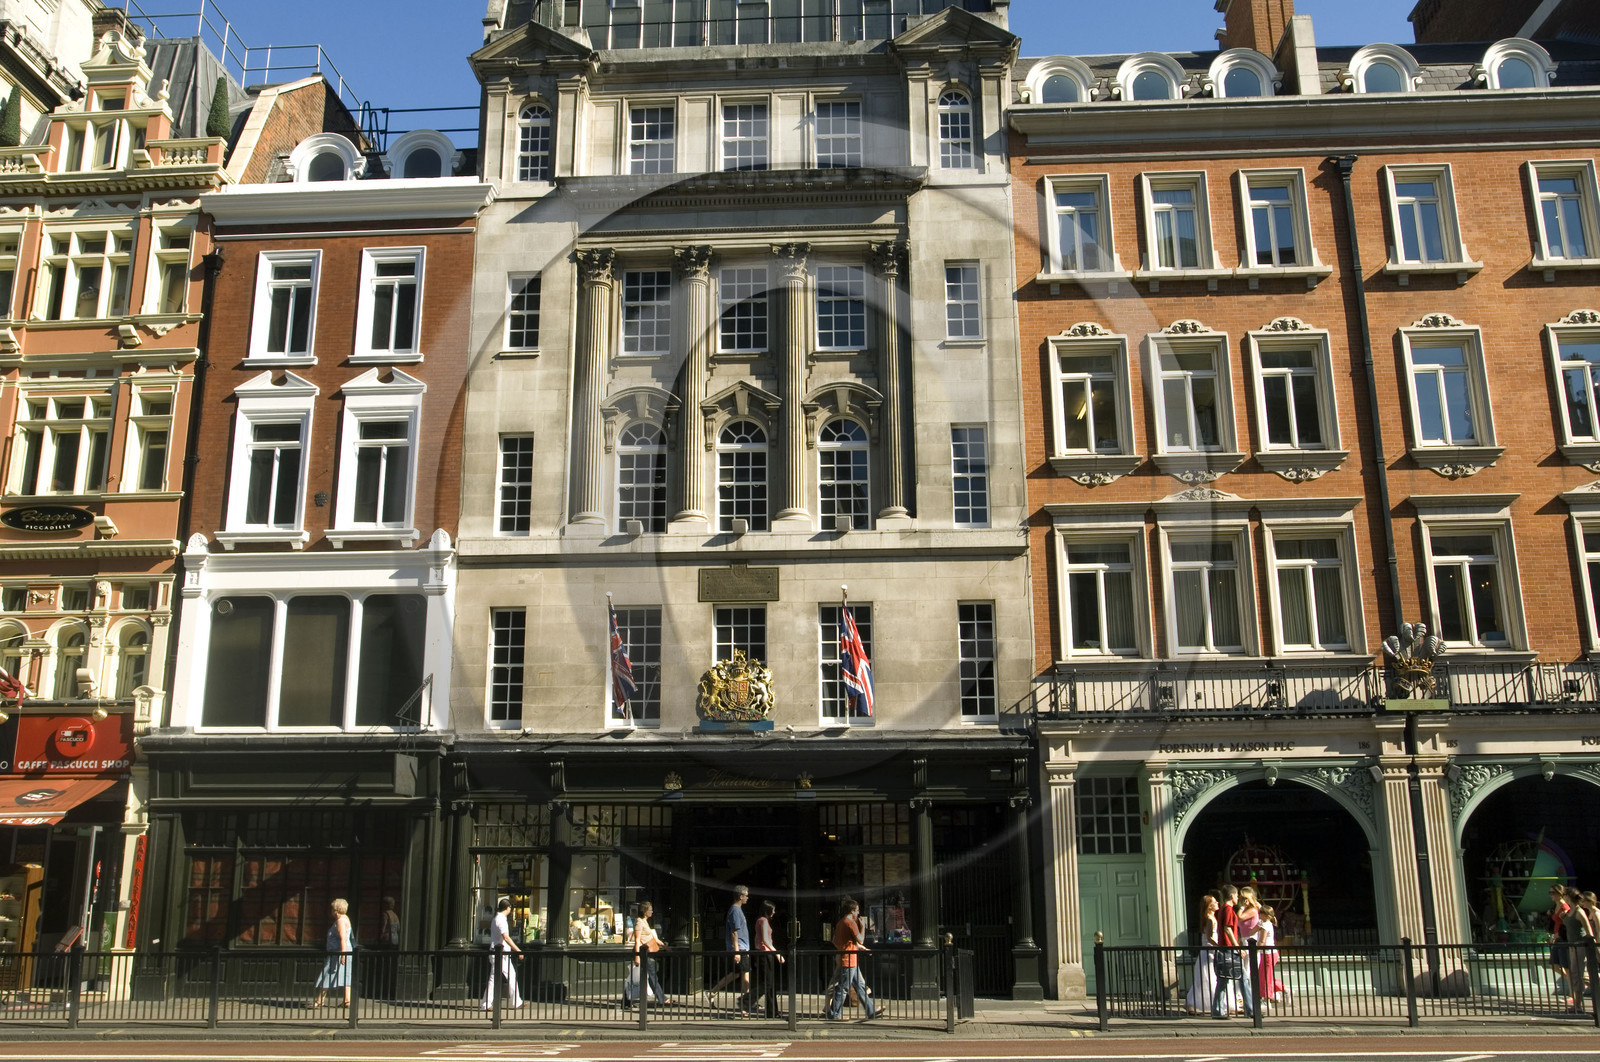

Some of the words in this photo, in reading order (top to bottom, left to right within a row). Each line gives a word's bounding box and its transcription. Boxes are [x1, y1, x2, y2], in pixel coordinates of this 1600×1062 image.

[20, 509, 76, 525] Biagio
[1158, 743, 1214, 754] FORTNUM
[1217, 743, 1226, 753] &
[1229, 741, 1270, 753] MASON
[1273, 741, 1296, 752] PLC
[1358, 741, 1370, 750] 186
[1446, 739, 1458, 748] 185
[17, 760, 48, 770] CAFFE
[50, 760, 98, 769] PASCUCCI
[101, 759, 130, 769] SHOP
[137, 838, 145, 862] BAR
[127, 868, 140, 947] RISTORANTE
